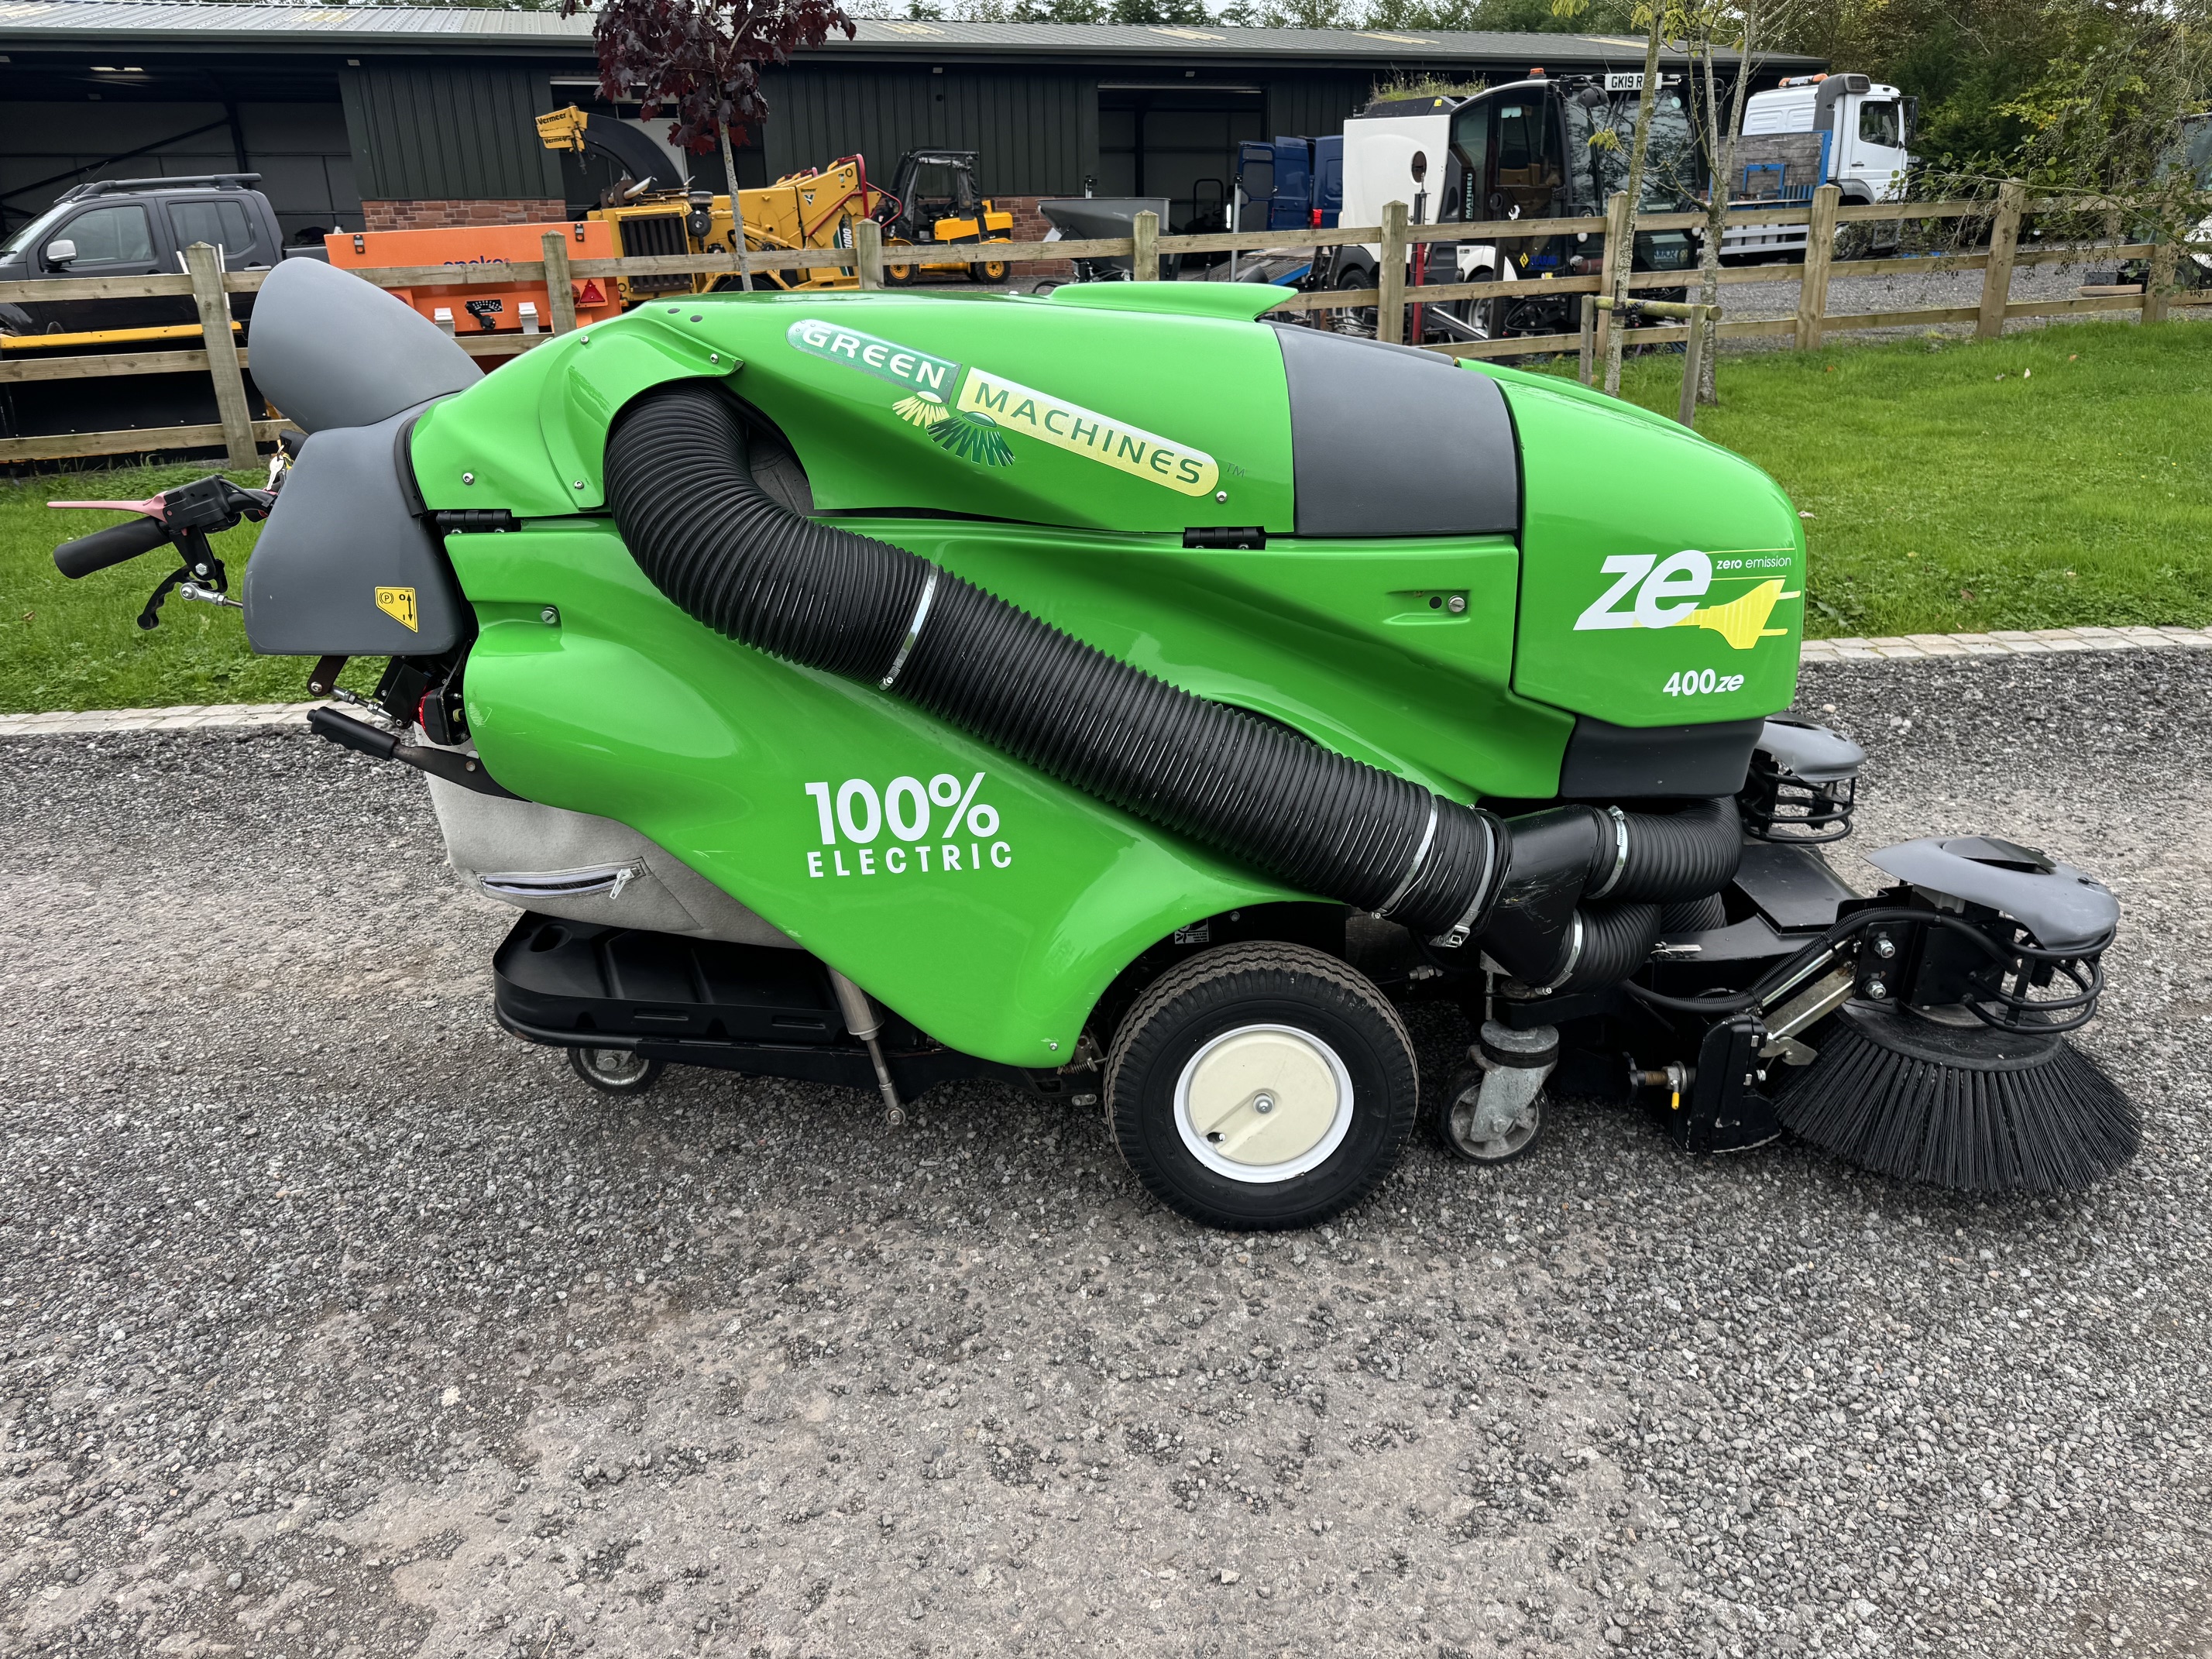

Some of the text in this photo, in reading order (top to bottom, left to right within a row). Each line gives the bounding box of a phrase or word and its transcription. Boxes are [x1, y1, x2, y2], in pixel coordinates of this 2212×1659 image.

[1612, 76, 1634, 88] GK19
[538, 113, 566, 125] Vermeer
[802, 325, 946, 390] GREEN
[974, 382, 1203, 485] MACHINES
[1716, 555, 1791, 569] zero emission
[1573, 550, 1712, 630] ze
[805, 772, 1000, 845] 100%
[807, 841, 1012, 878] ELECTRIC
